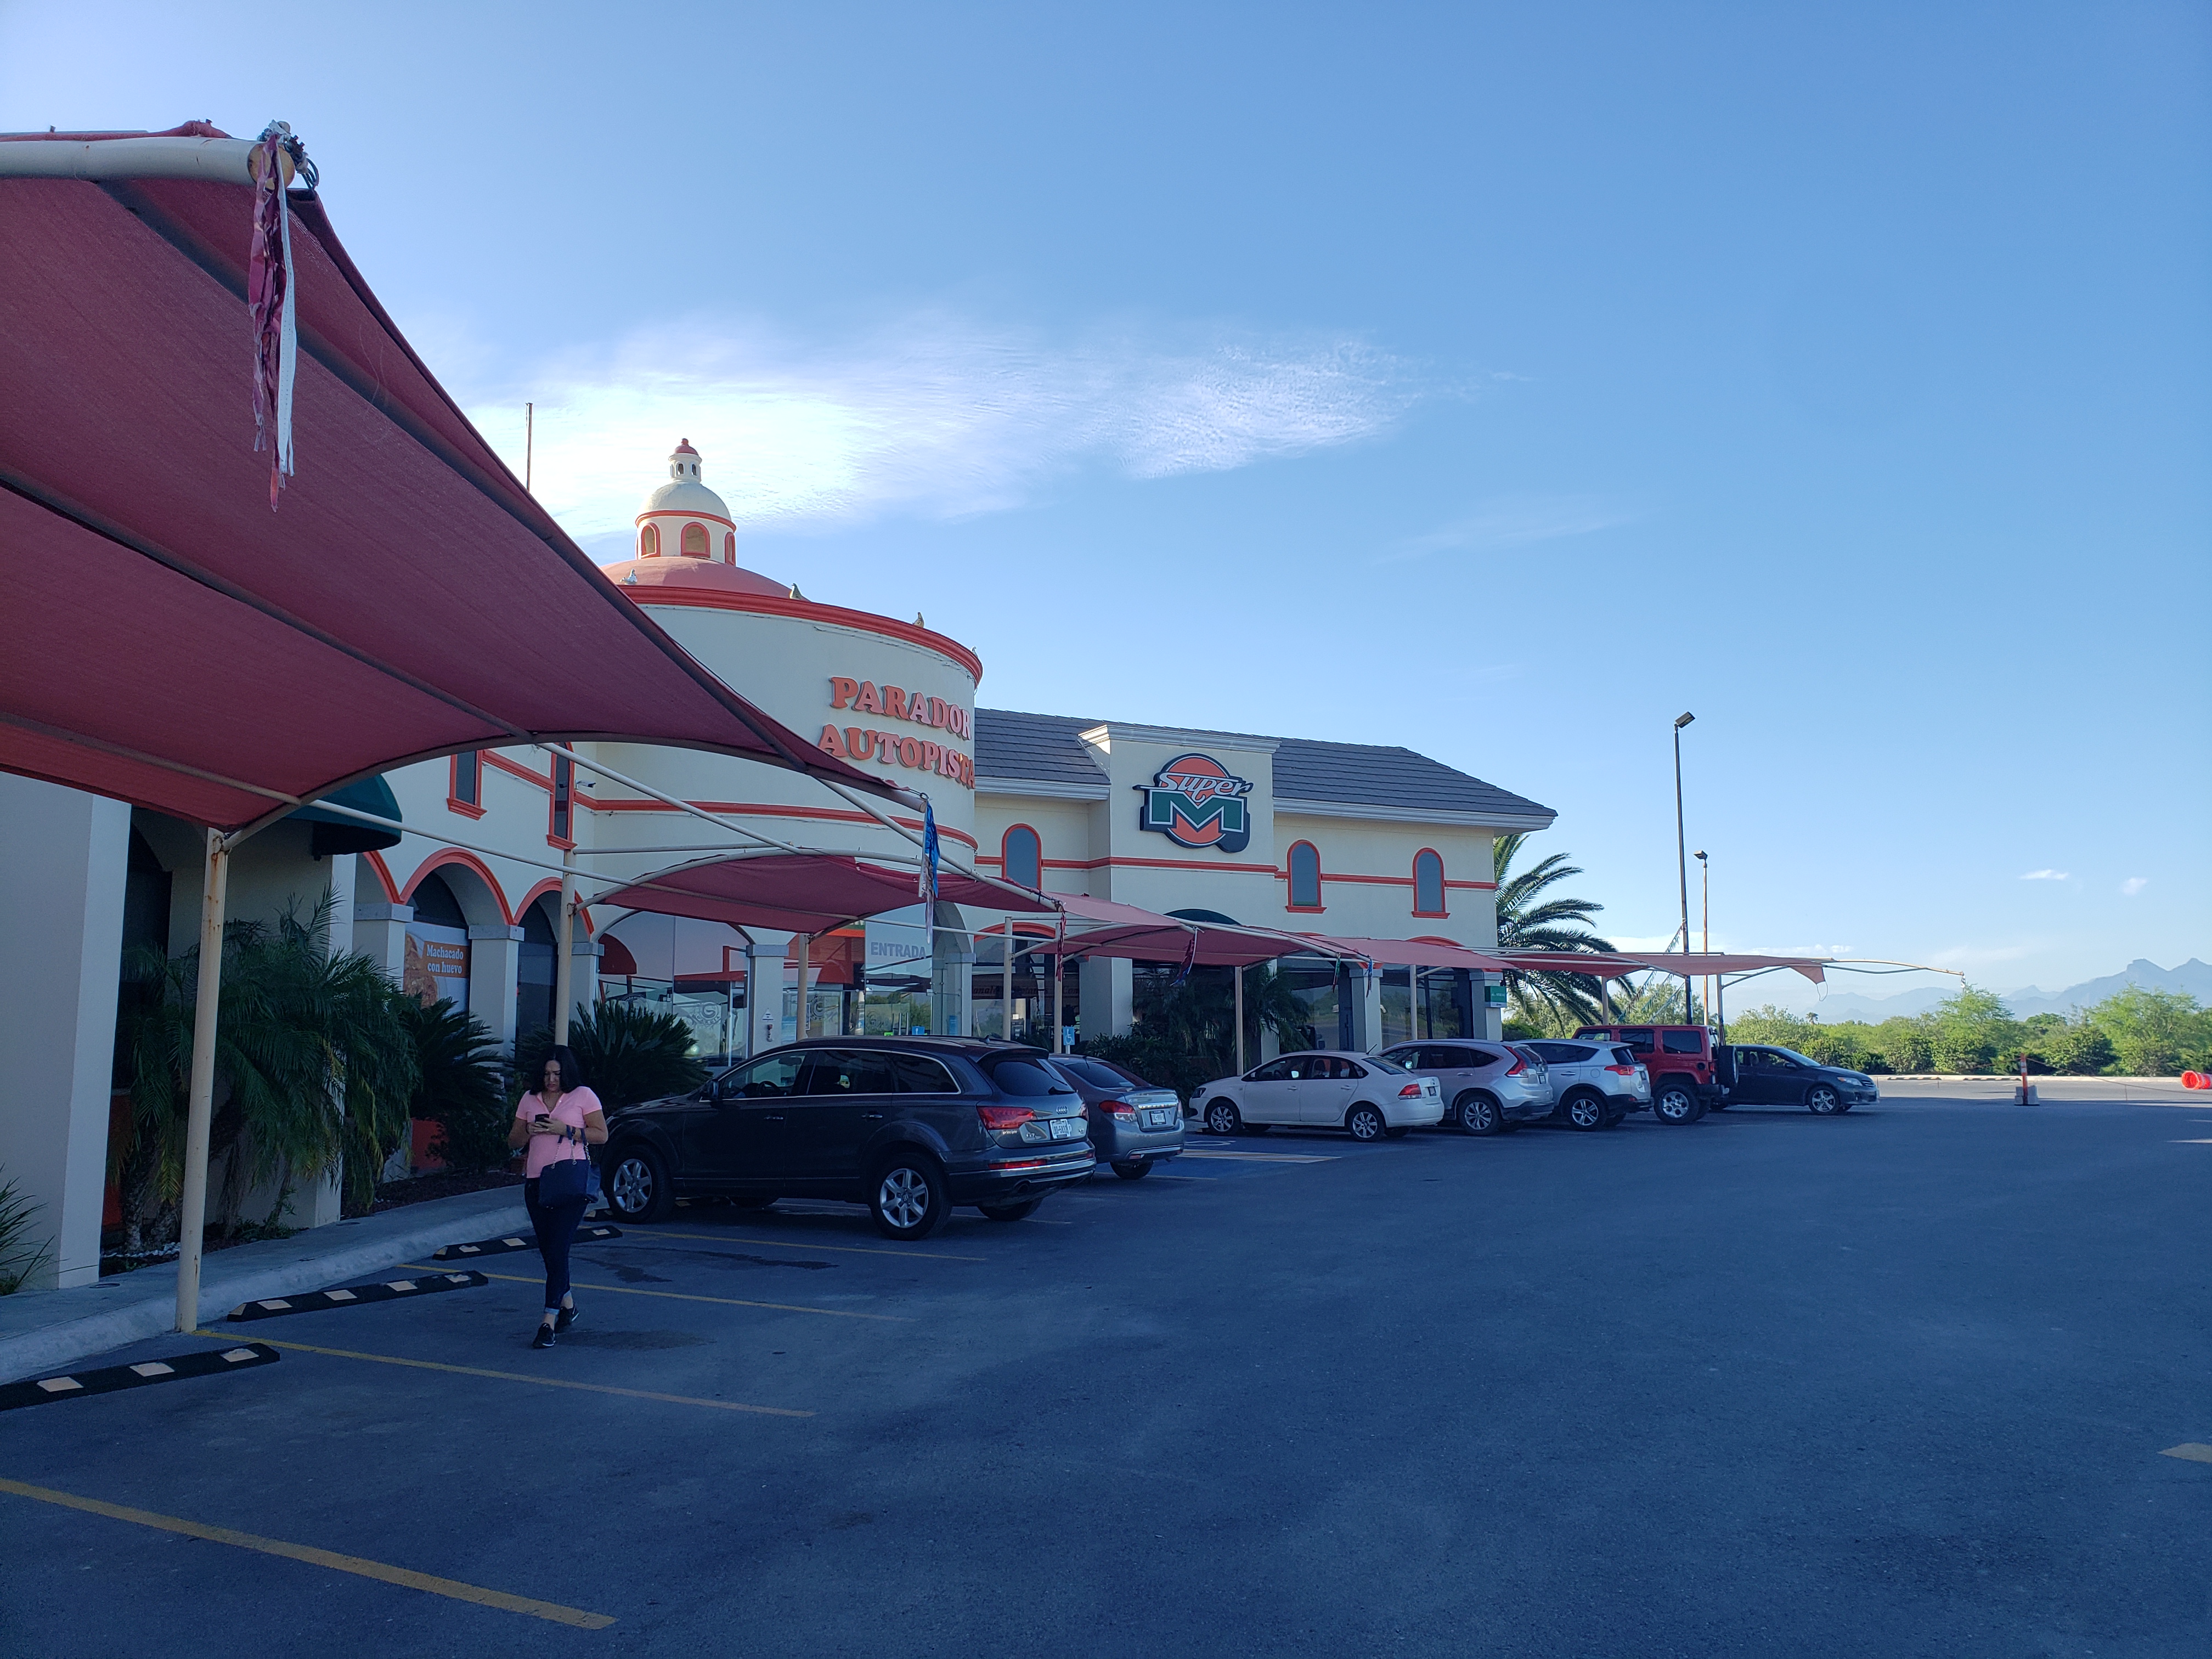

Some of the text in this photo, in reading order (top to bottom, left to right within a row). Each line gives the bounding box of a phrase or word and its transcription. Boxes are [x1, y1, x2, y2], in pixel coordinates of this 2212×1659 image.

[830, 676, 972, 741] PARADOR
[819, 724, 975, 789] AUTOPISTA
[1141, 771, 1252, 803] Super
[426, 944, 464, 960] Machacado
[871, 942, 926, 959] ENTRADA
[427, 961, 462, 974] con huevo
